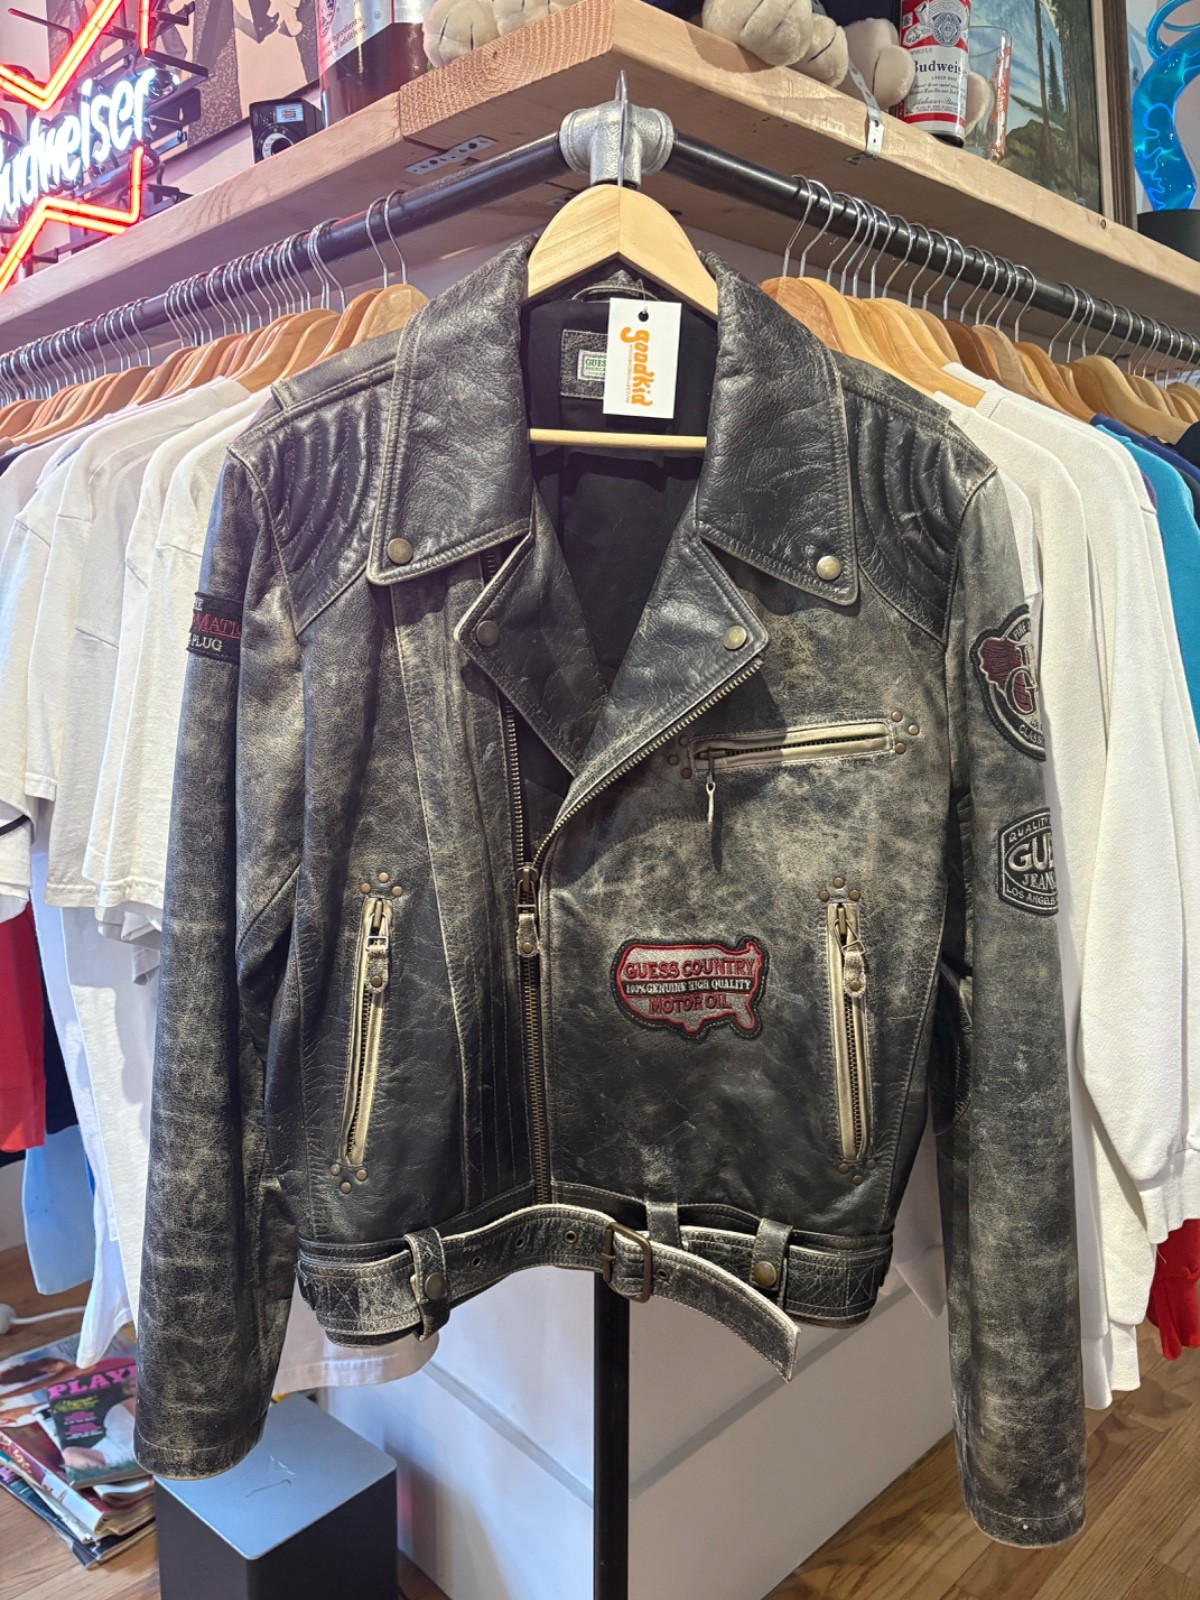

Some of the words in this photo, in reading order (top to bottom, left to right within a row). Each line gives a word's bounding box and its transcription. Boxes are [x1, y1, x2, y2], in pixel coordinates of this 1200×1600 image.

[620, 327, 655, 407] goodkid
[1006, 883, 1025, 899] LOS
[623, 961, 680, 980] GUESS
[681, 958, 755, 978] COUNTRY
[646, 982, 687, 993] GENUINE
[688, 979, 710, 991] HIGH
[711, 978, 752, 990] QUALITY
[649, 993, 703, 1015] MOTOR
[704, 993, 732, 1010] OIL
